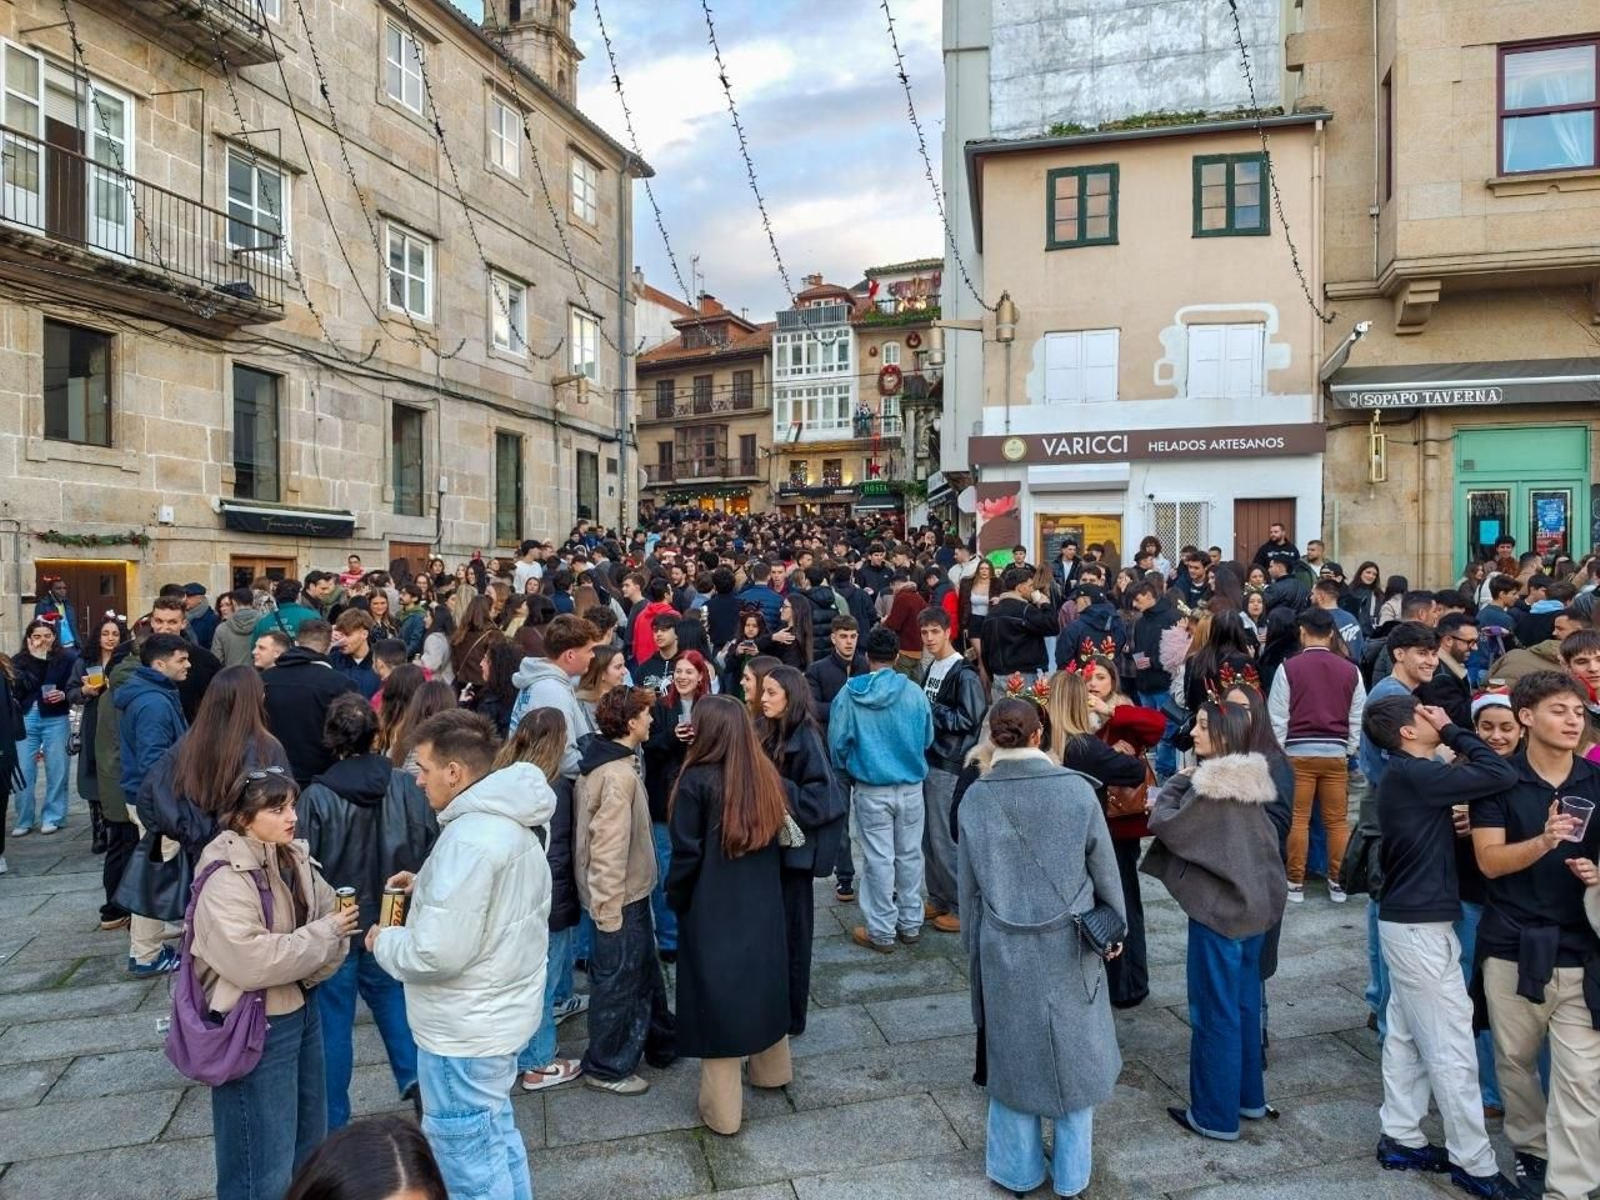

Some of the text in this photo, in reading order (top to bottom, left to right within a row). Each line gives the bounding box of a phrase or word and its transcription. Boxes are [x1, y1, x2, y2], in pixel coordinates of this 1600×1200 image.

[1364, 389, 1498, 406] SOPAPO TAVERNA
[1042, 435, 1284, 456] VARICCI HELADOS ARTESANOS
